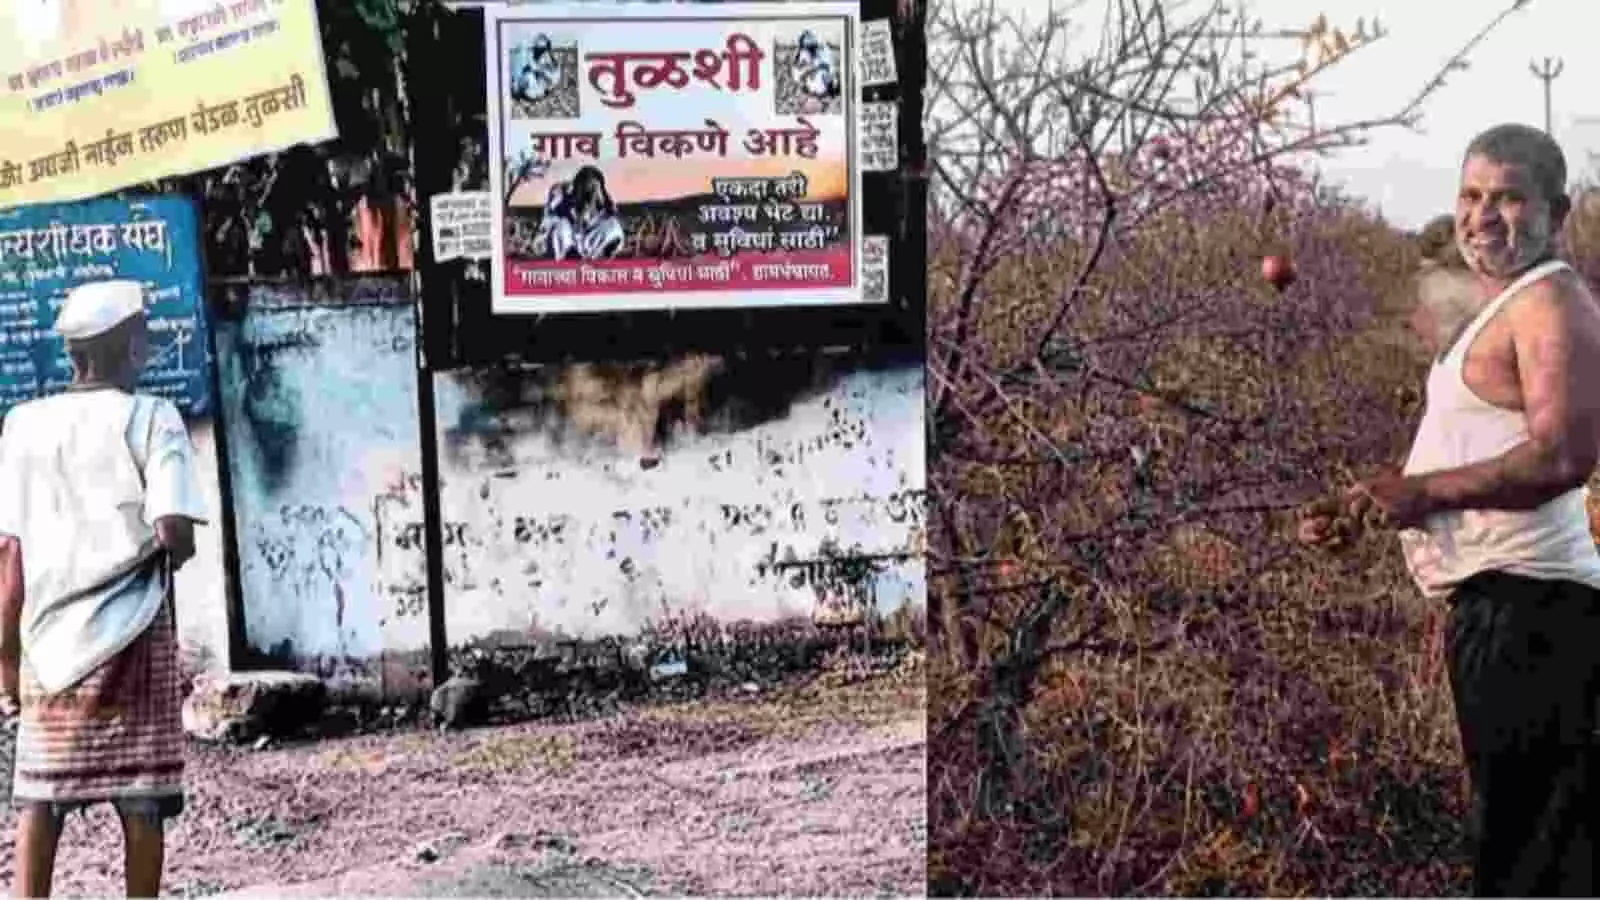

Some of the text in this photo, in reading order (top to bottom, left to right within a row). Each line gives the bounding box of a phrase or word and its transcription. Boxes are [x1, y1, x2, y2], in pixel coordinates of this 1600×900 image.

[584, 33, 764, 108] तुळशी
[531, 131, 602, 159] गाव
[615, 118, 729, 159] विकणे
[742, 118, 820, 160] आहे
[712, 176, 768, 204] एकदा
[763, 198, 794, 222] भेट
[0, 221, 118, 258] त्यशोधक
